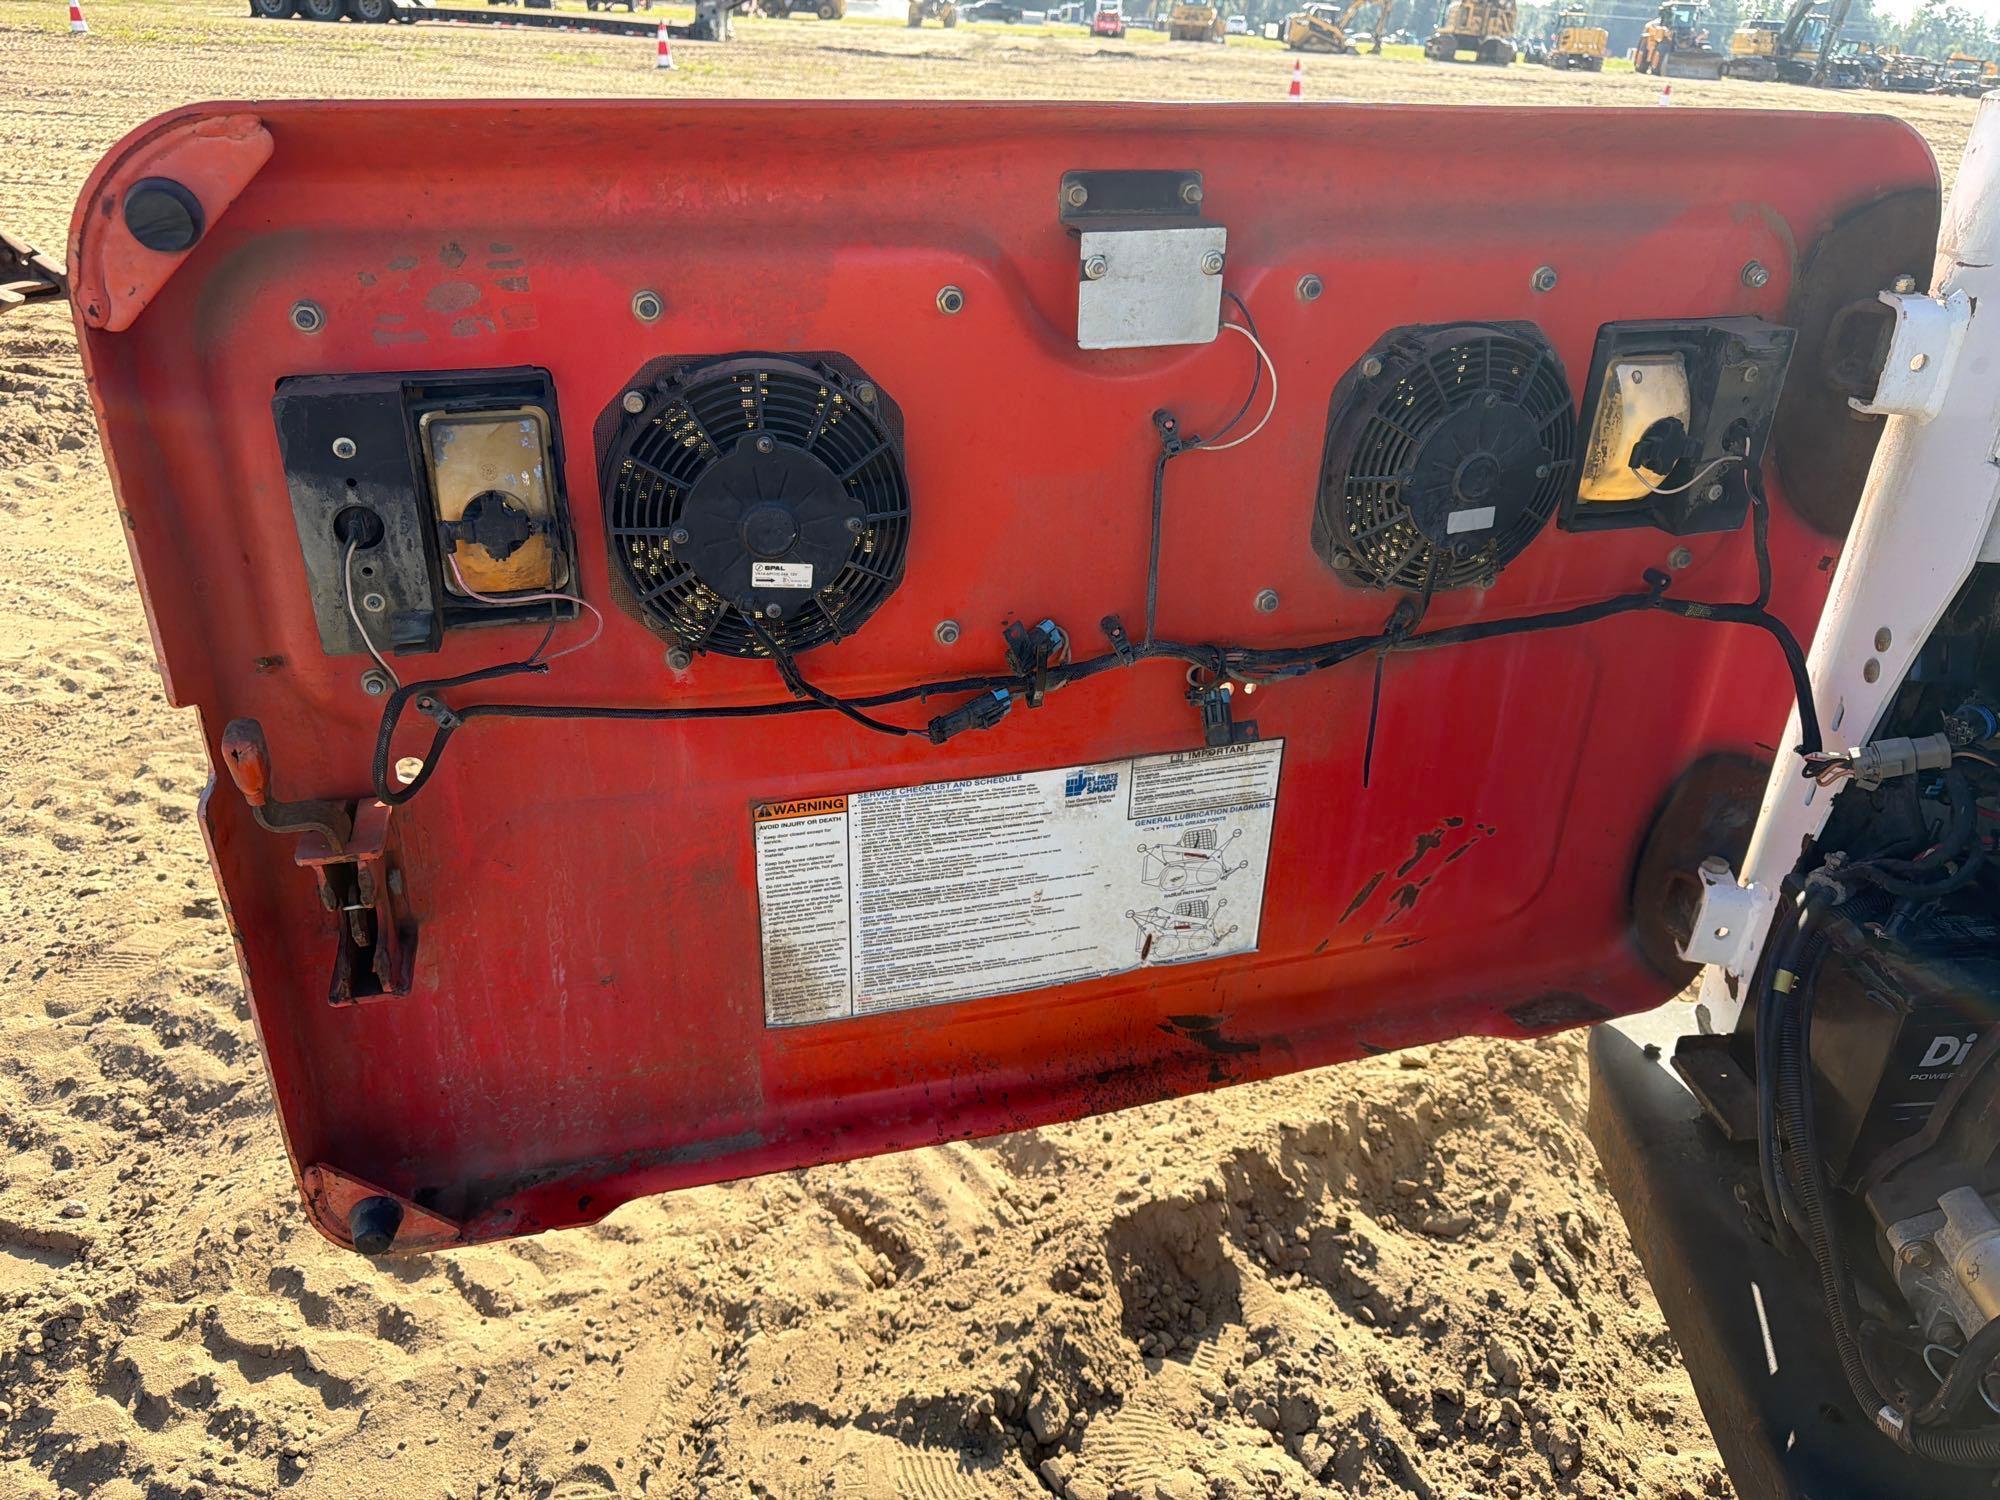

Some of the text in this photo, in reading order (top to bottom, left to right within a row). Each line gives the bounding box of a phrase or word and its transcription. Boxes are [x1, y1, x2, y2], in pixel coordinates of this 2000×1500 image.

[1188, 744, 1250, 760] IMPORTANT
[858, 789, 897, 799] SERVICE
[900, 783, 950, 795] CHECKLIST
[953, 780, 972, 788] AND
[975, 775, 1022, 786] SCHEDULE
[1087, 784, 1118, 794] SMART
[773, 799, 844, 815] WARNING
[1135, 802, 1270, 827] GENERAL LUBRICATION DIAGRAMS
[1919, 1033, 1978, 1067] Di
